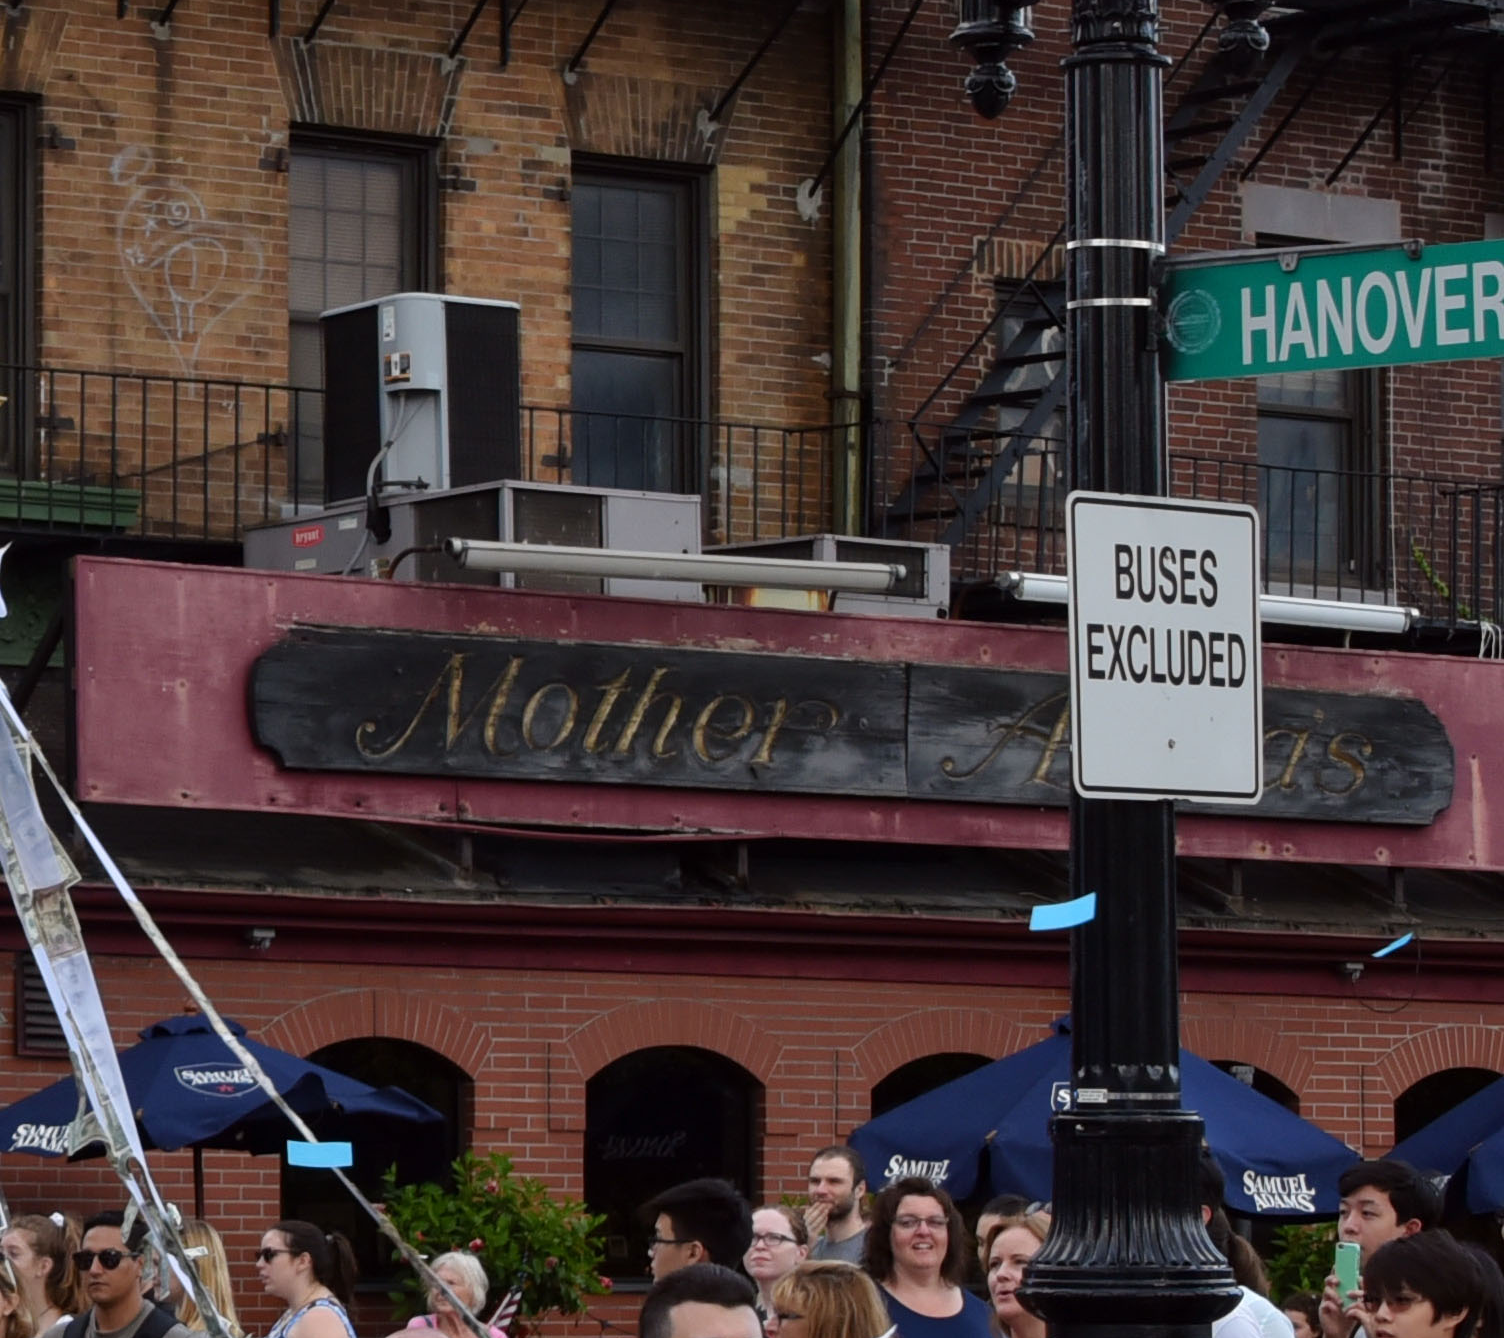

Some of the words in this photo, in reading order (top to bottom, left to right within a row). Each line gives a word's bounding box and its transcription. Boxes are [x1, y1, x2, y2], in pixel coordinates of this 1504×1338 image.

[1114, 543, 1219, 608] BUSES
[1086, 623, 1247, 689] EXCLUDED
[355, 647, 840, 766] Mother
[939, 687, 1373, 797] Aa's
[12, 1124, 69, 1143] SAMU
[883, 1154, 950, 1181] SAMUEL
[1242, 1169, 1317, 1198] SAMUEL
[1253, 1190, 1317, 1214] ADAMS
